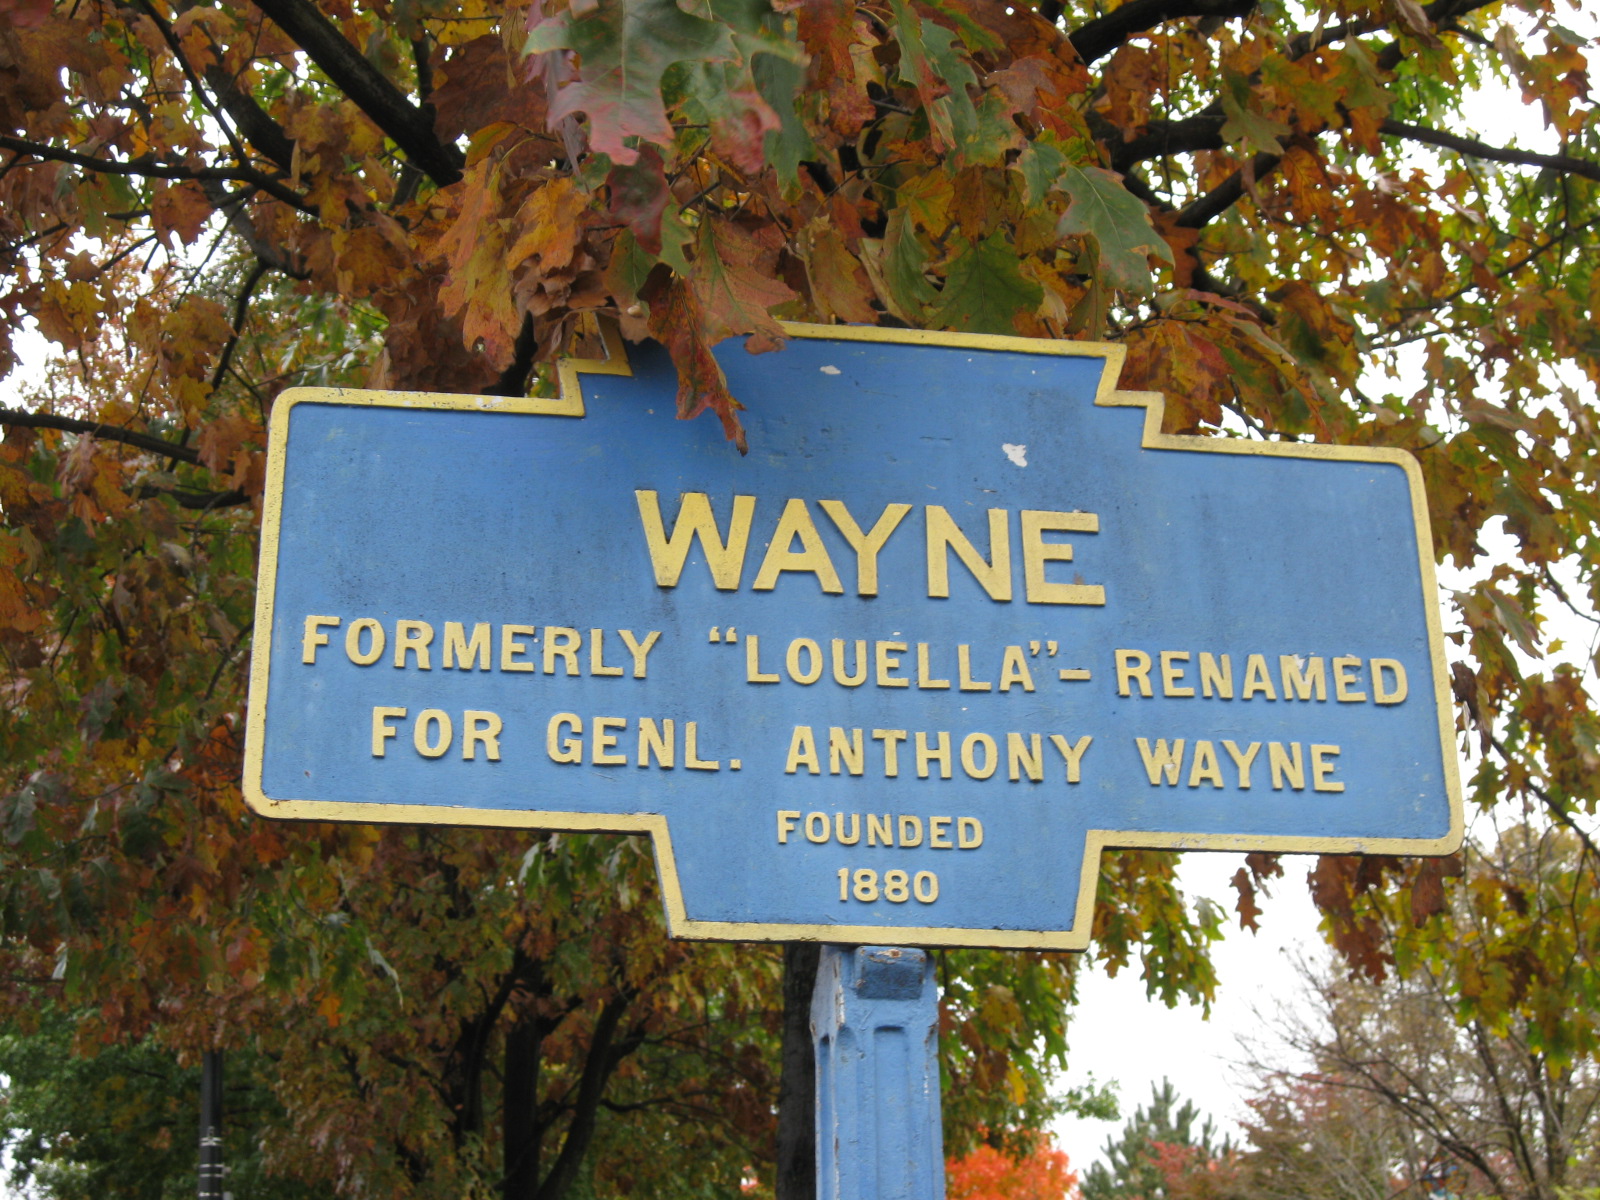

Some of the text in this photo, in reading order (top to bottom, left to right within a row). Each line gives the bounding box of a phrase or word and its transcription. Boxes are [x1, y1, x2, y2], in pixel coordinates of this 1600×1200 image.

[635, 489, 1107, 606] WAYNE
[302, 615, 662, 679] FORMERLY
[1114, 648, 1409, 705] RENAMED
[372, 706, 1345, 793] FOR GENL. ANTHONY WAYNE
[777, 810, 984, 850] FOUNDED
[838, 868, 940, 904] 1880
